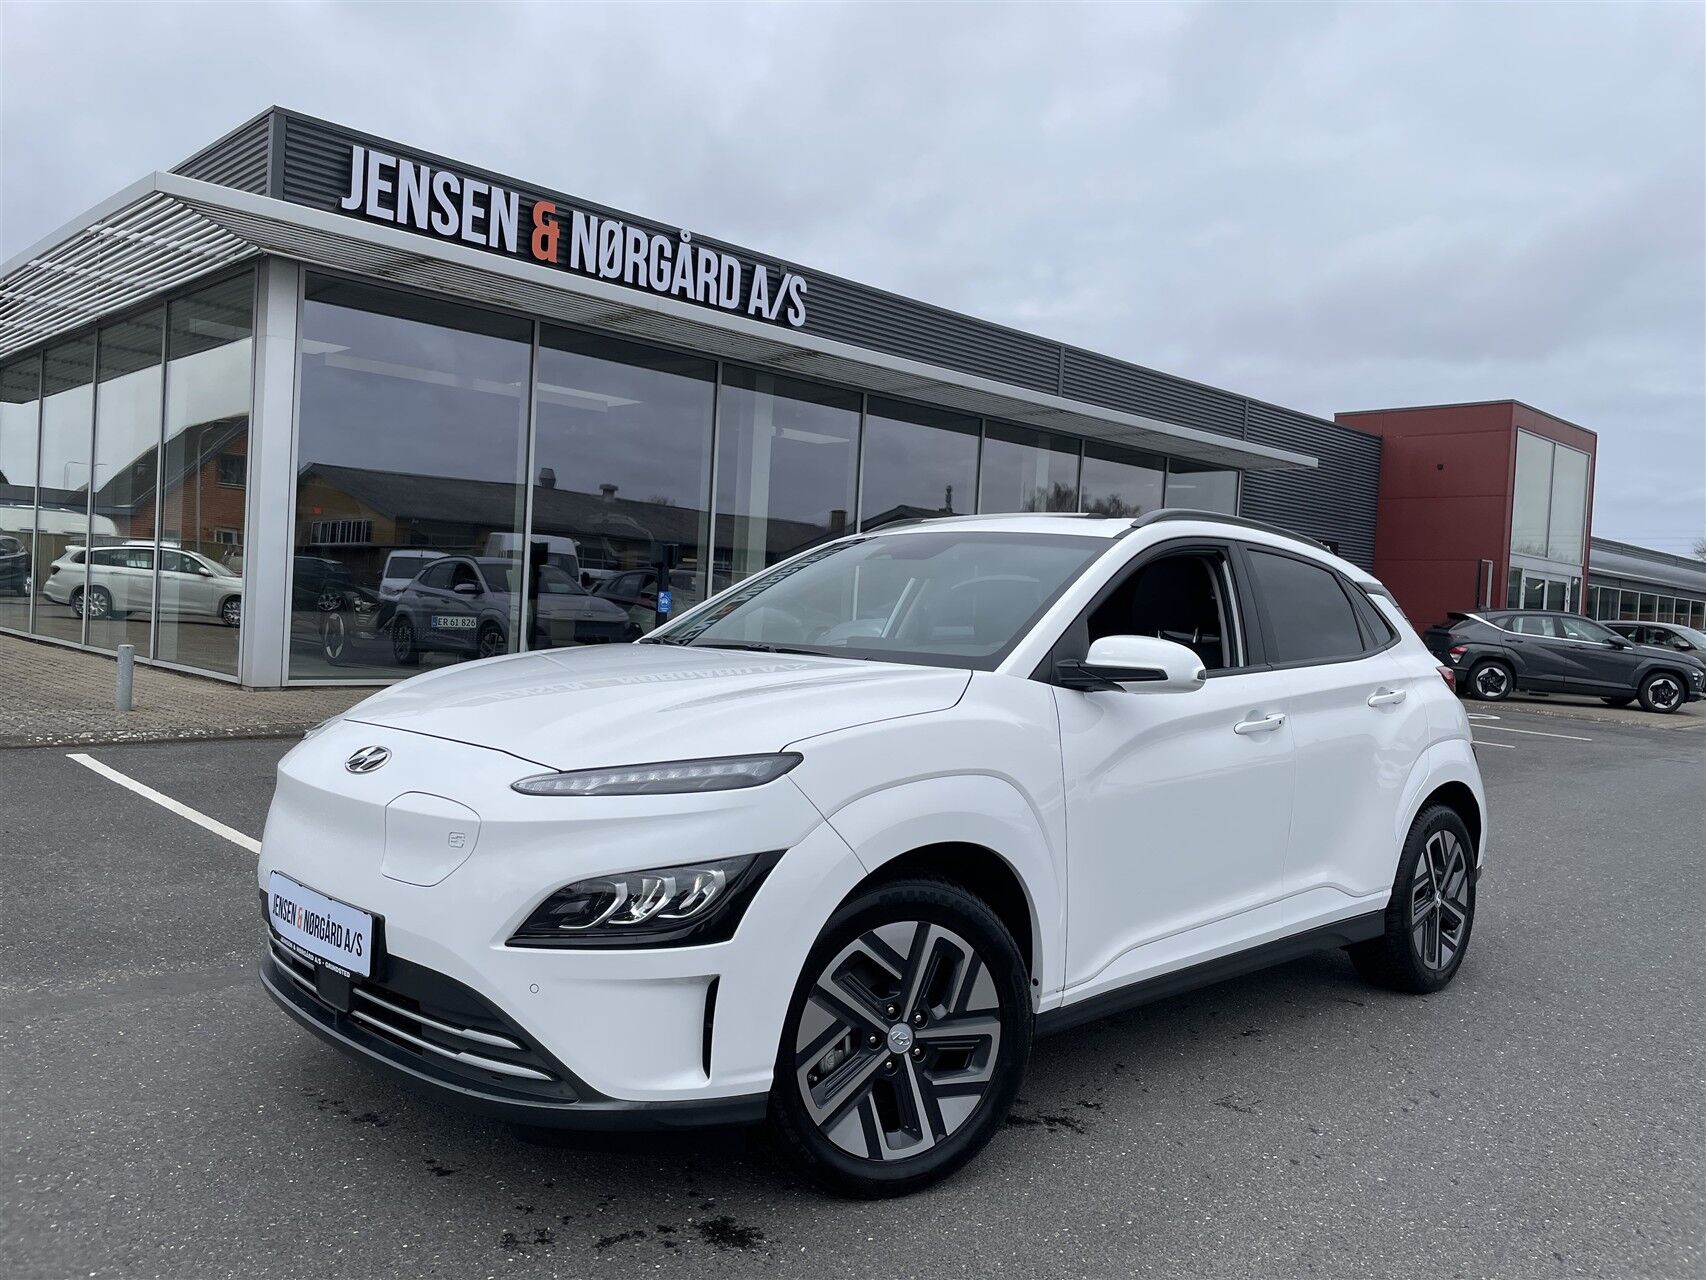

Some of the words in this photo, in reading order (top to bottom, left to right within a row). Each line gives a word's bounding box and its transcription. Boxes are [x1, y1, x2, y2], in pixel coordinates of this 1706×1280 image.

[341, 145, 520, 253] JENSEN
[531, 200, 560, 263] &
[570, 210, 742, 309] NØRGÅRD
[748, 264, 808, 327] A/S
[437, 617, 449, 626] ER
[450, 618, 459, 627] 61
[461, 618, 476, 627] 826
[272, 893, 297, 926] JENSEN
[297, 907, 303, 929] &
[303, 909, 343, 948] NØRGÅRD
[344, 928, 363, 957] A/S
